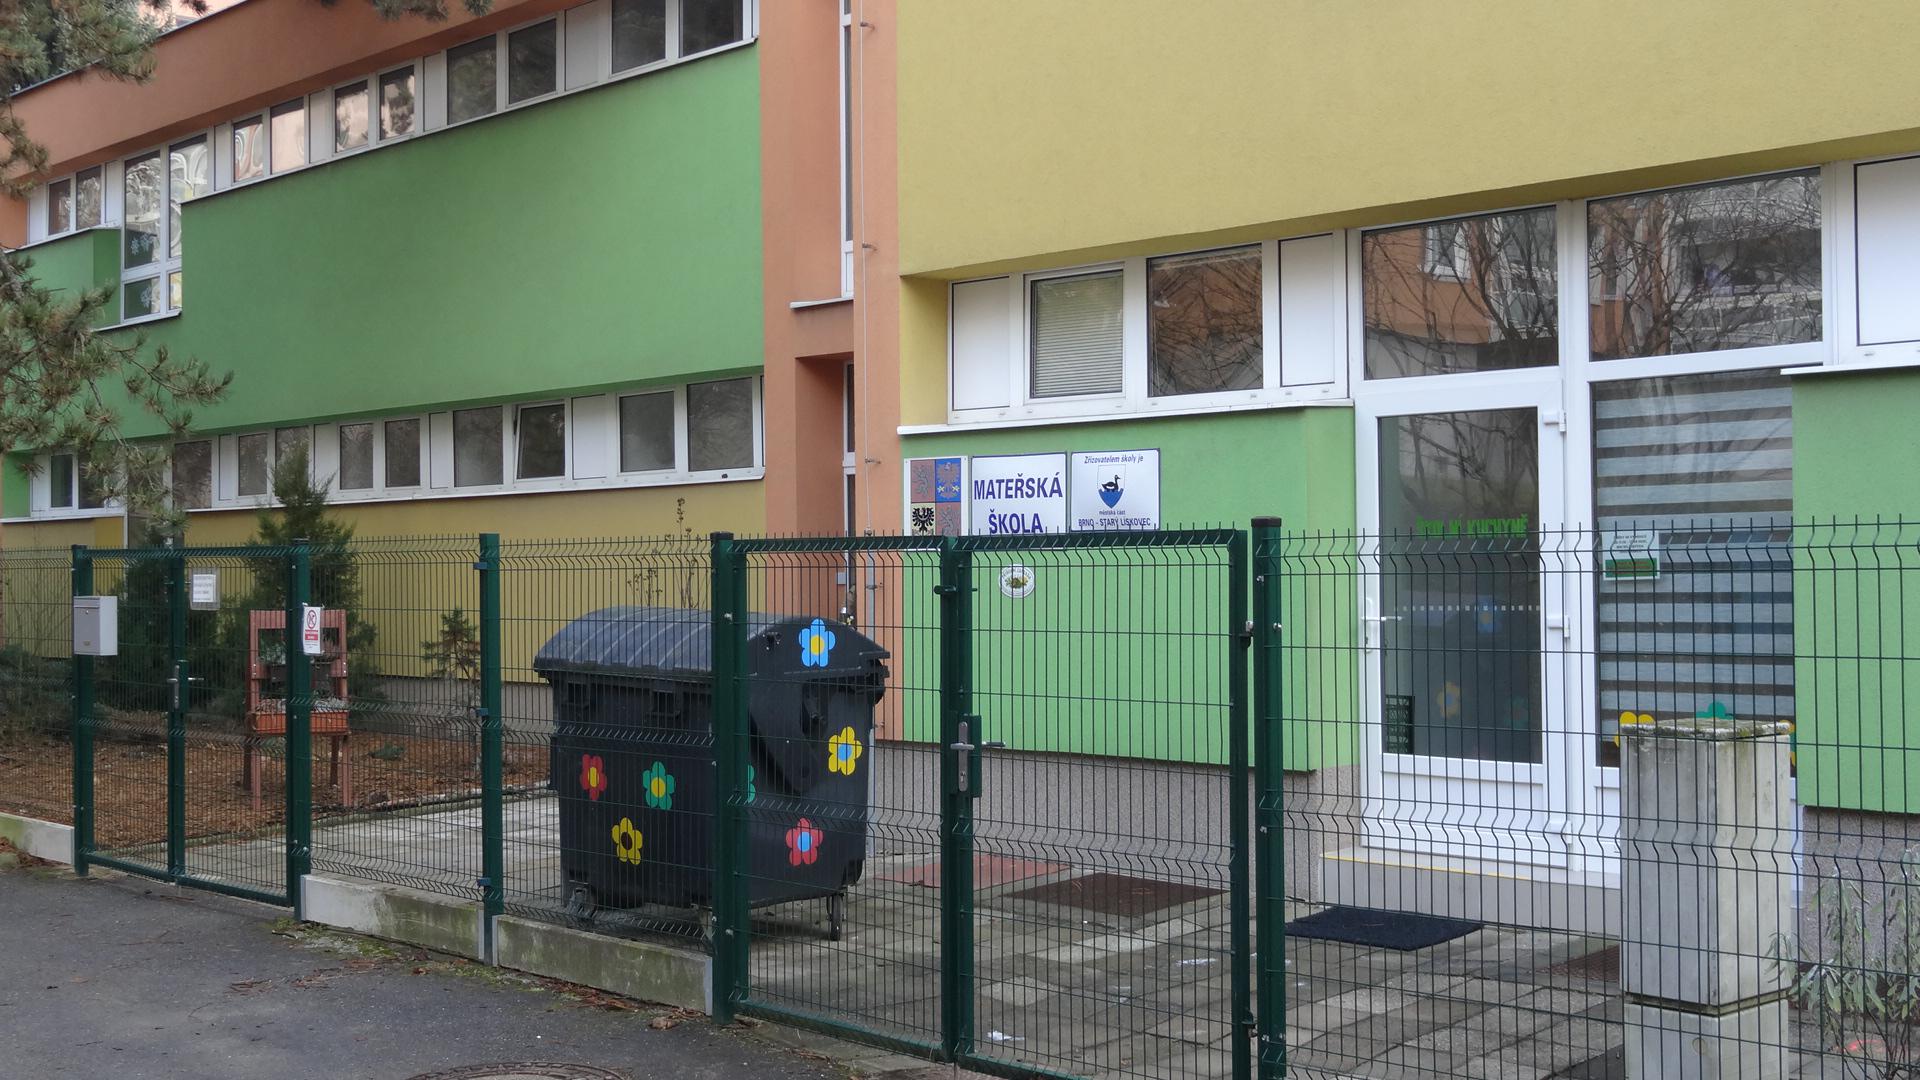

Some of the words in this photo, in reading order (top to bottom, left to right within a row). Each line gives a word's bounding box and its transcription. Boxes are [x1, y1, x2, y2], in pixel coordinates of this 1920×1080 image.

[1084, 455, 1119, 464] Zřizovatelem
[1121, 453, 1136, 463] školy
[1137, 454, 1144, 463] je
[974, 472, 1063, 500] MATEŘSKÁ
[988, 508, 1043, 534] ŠKOLA
[1078, 518, 1094, 527] BRNO
